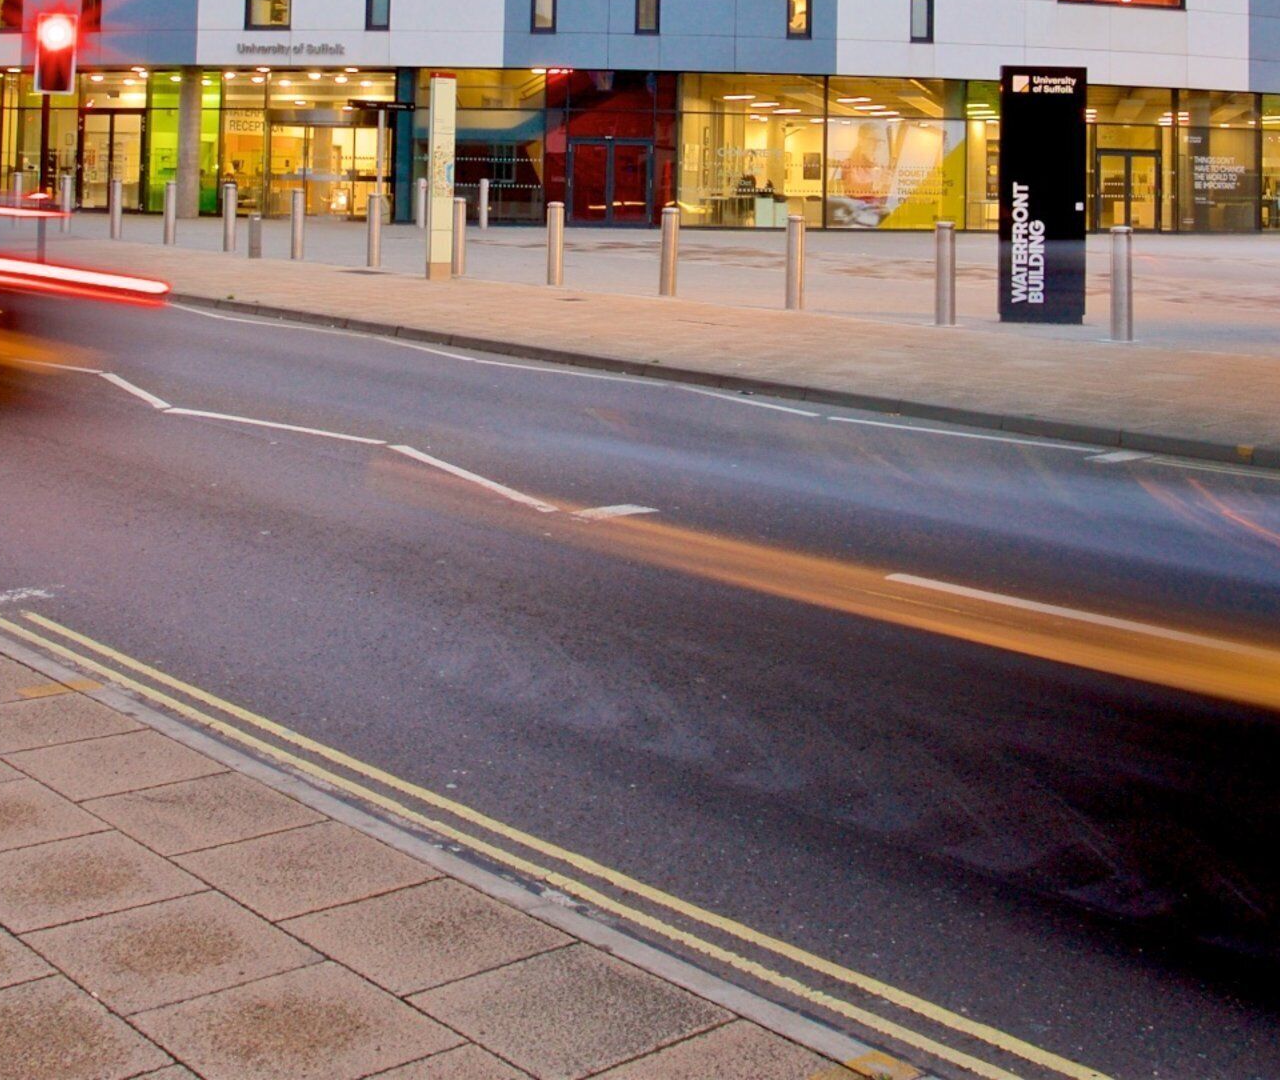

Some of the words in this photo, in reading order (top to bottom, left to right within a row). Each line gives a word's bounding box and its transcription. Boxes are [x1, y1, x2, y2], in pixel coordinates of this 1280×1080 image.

[236, 42, 291, 57] University
[293, 42, 305, 55] of
[306, 42, 346, 56] Suffolk
[1032, 75, 1077, 87] University
[1032, 84, 1043, 94] of
[1043, 84, 1074, 95] Suffolk
[229, 119, 284, 133] RECEPTON
[1205, 173, 1228, 181] WORLD
[1228, 173, 1237, 181] TO
[1011, 181, 1030, 304] WATERFRONT
[1028, 219, 1046, 304] BUILDING
